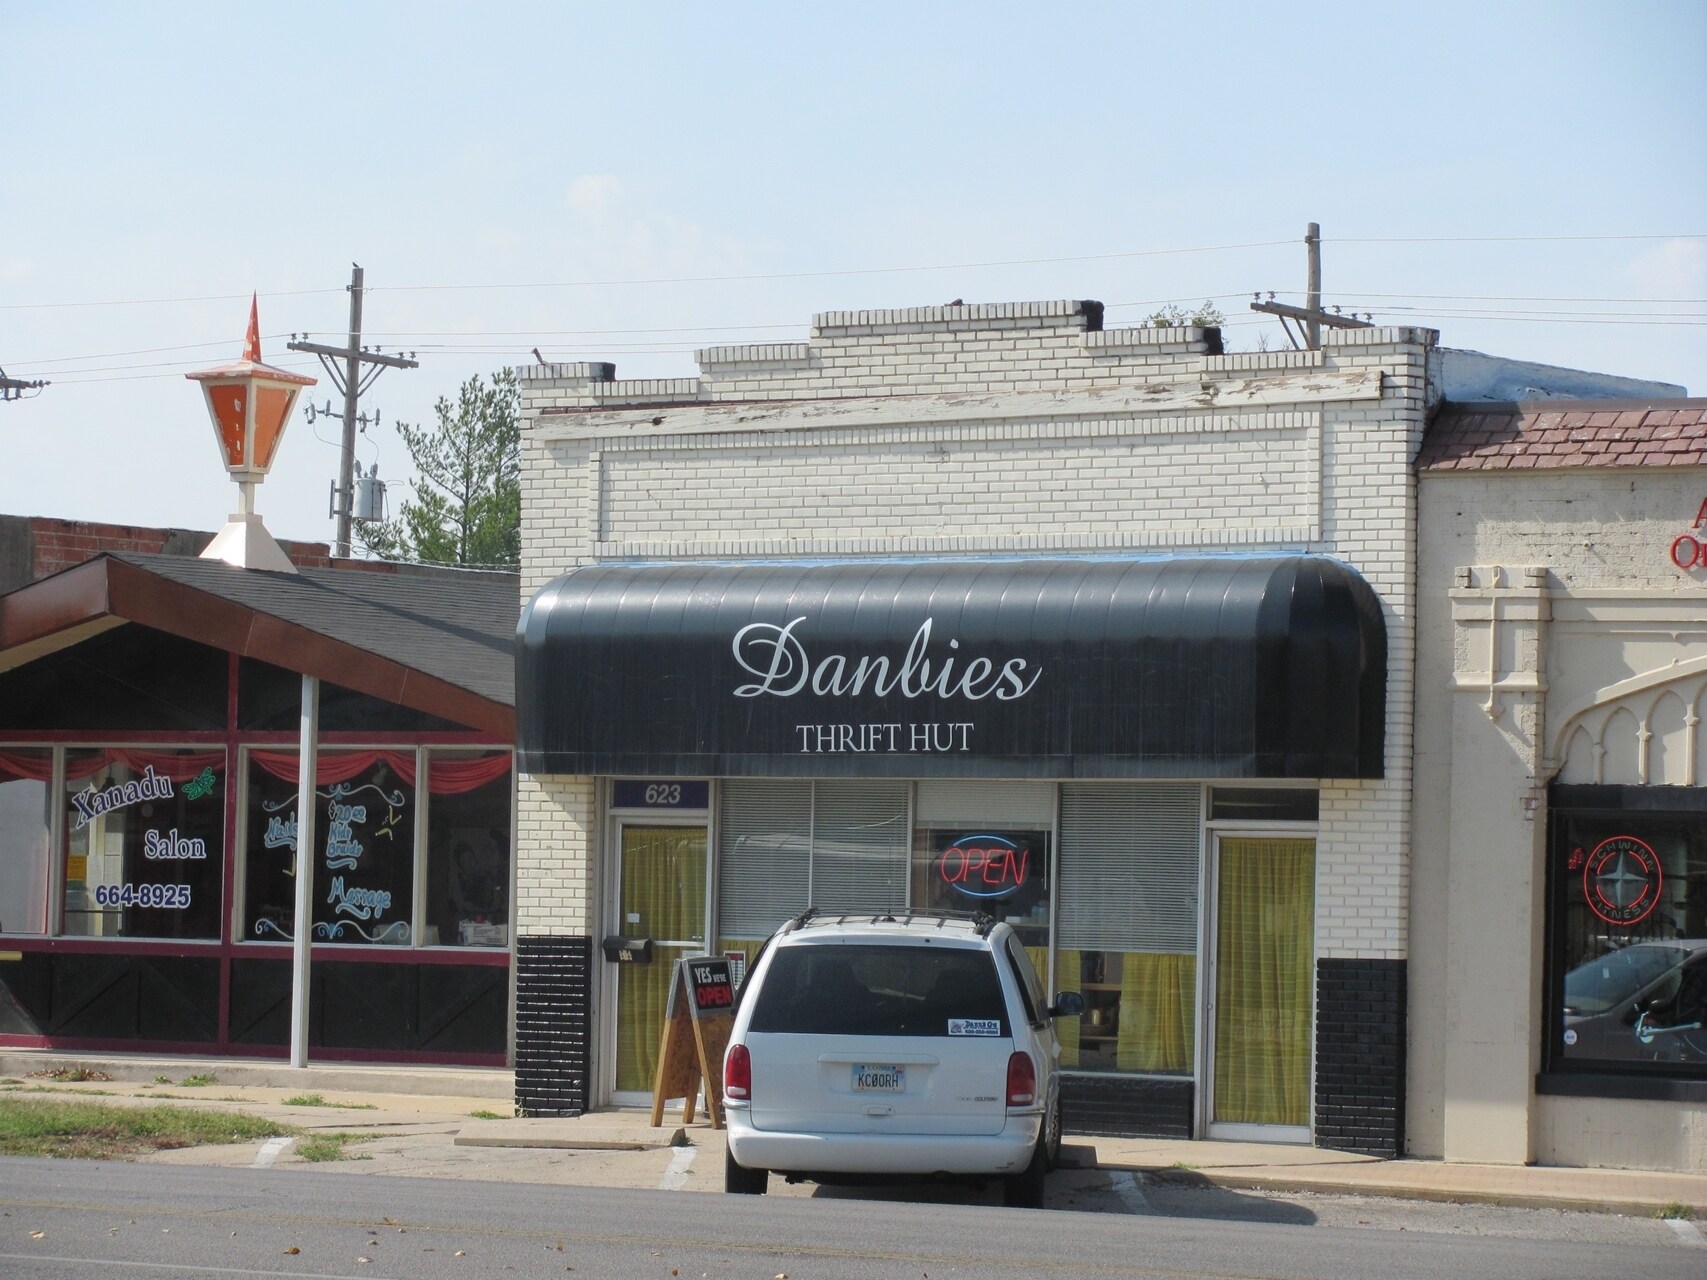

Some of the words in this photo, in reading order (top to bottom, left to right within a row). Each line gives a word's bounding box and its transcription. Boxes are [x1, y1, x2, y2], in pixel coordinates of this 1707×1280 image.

[732, 616, 1043, 700] Danbies
[796, 723, 902, 753] THRIFT
[909, 722, 975, 751] HUT
[72, 764, 175, 829] Xanadu
[645, 784, 681, 804] 623
[145, 828, 206, 859] Salon
[328, 821, 353, 841] Kids
[326, 839, 364, 857] Braids
[1589, 840, 1655, 871] SCHWINN
[941, 847, 1029, 885] OPEN
[95, 883, 191, 908] 664-8925
[327, 876, 392, 919] Massage
[694, 966, 712, 984] YES
[696, 985, 733, 1006] OPEN
